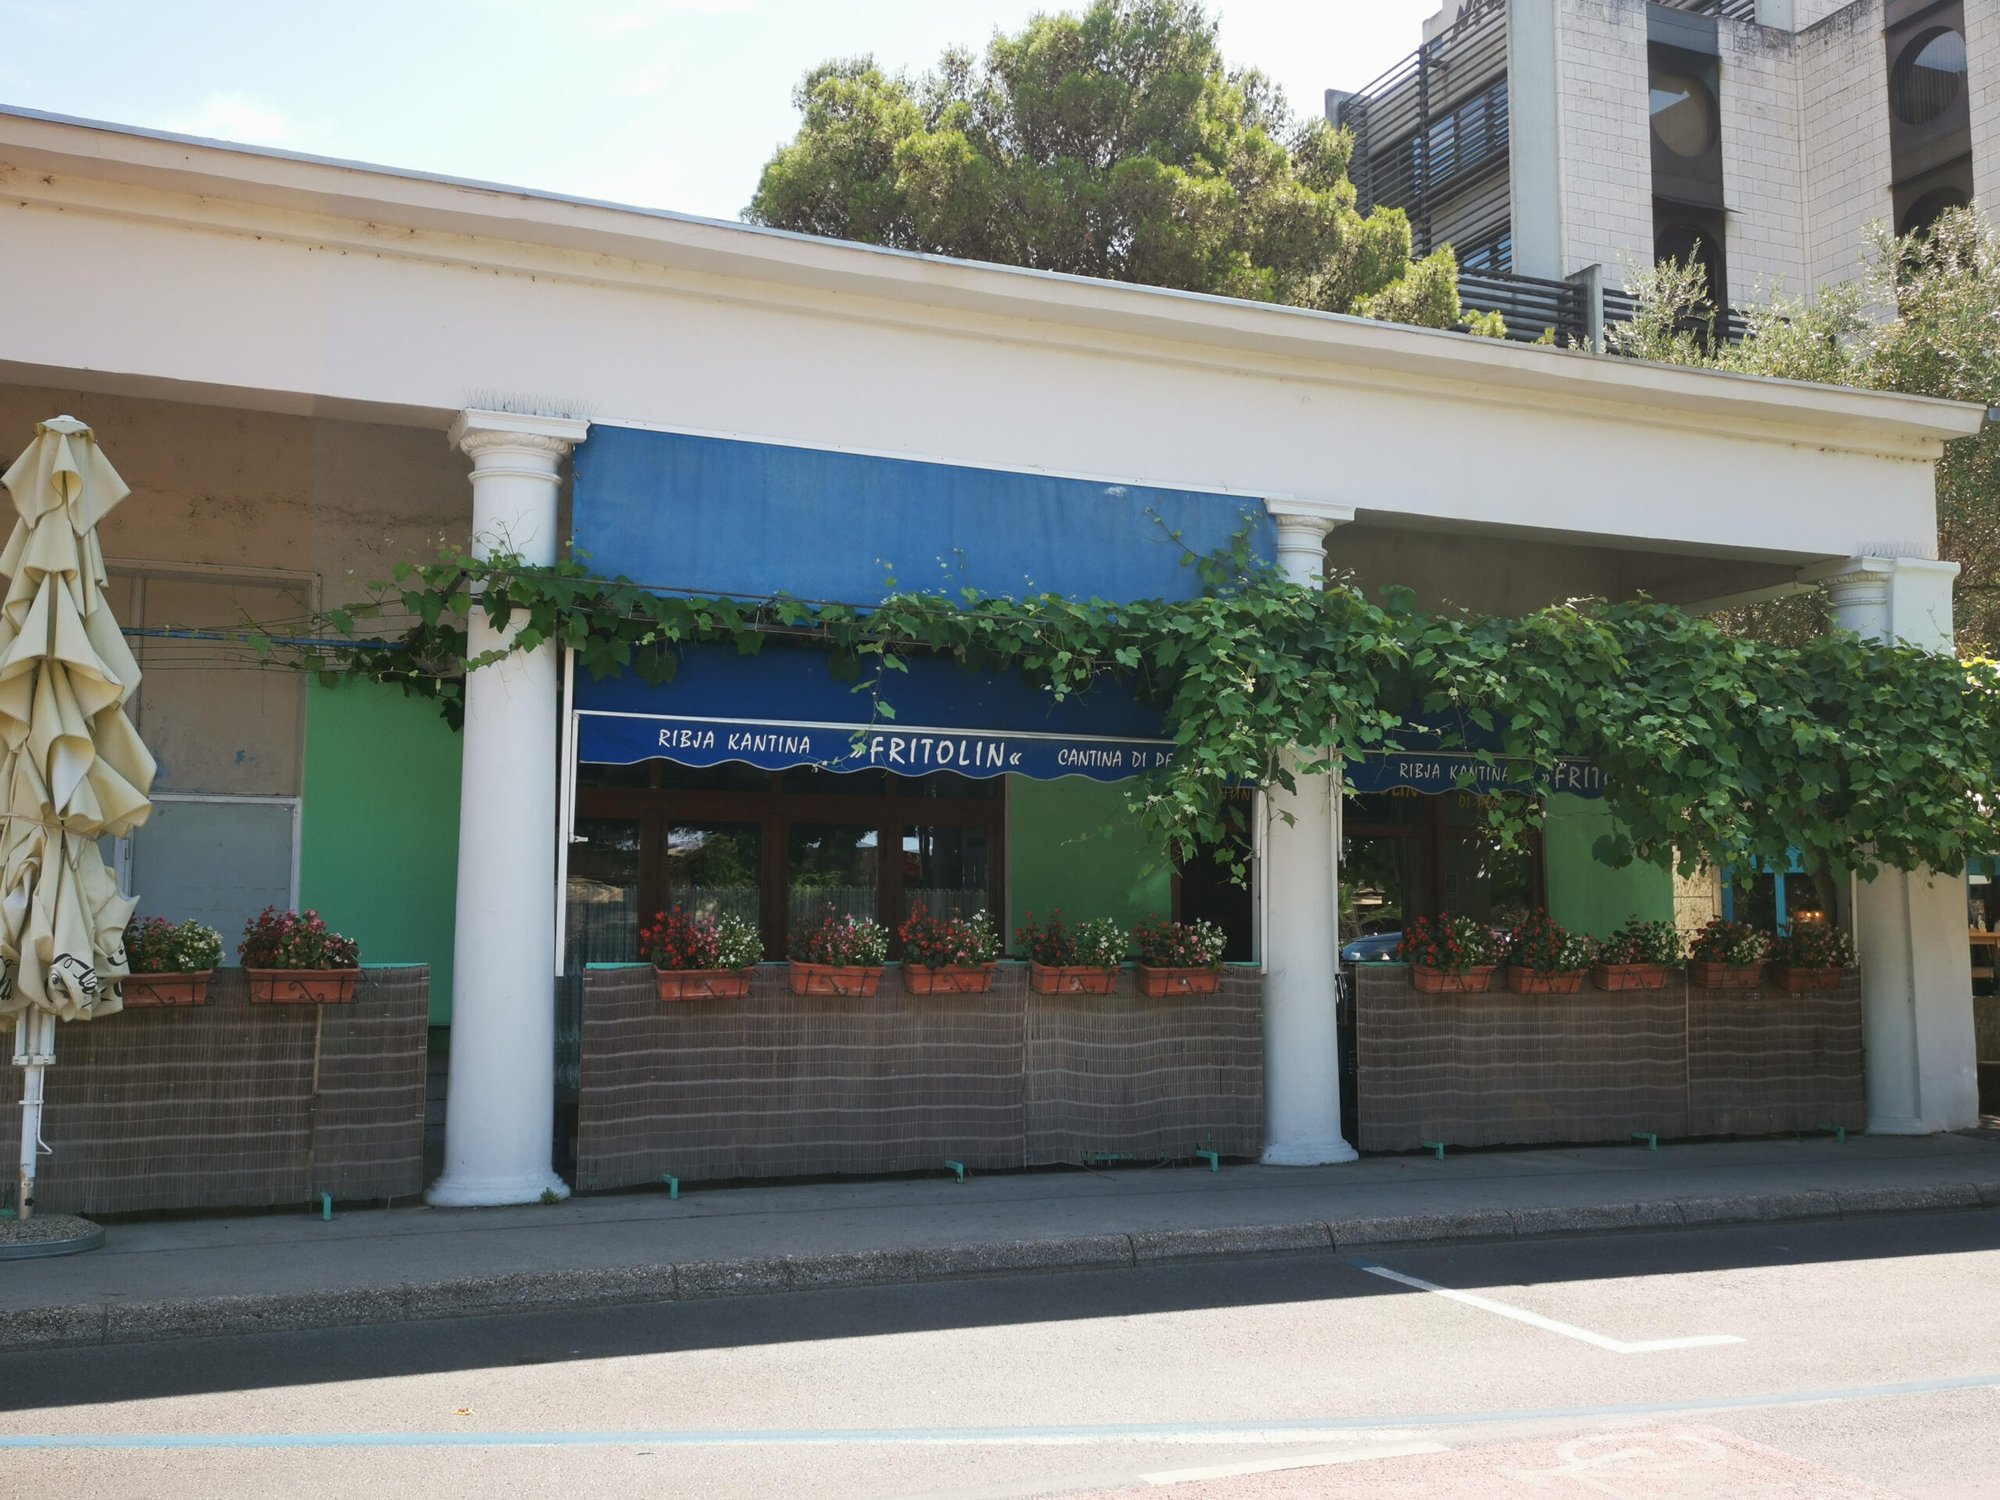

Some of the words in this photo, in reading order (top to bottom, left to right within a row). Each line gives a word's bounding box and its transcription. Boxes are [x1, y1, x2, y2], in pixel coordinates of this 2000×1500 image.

[658, 729, 715, 749] RIBJA
[728, 733, 811, 754] KANTINA
[1057, 749, 1122, 767] CANTINA
[1131, 751, 1147, 768] DI
[1400, 762, 1441, 780] RIBJA
